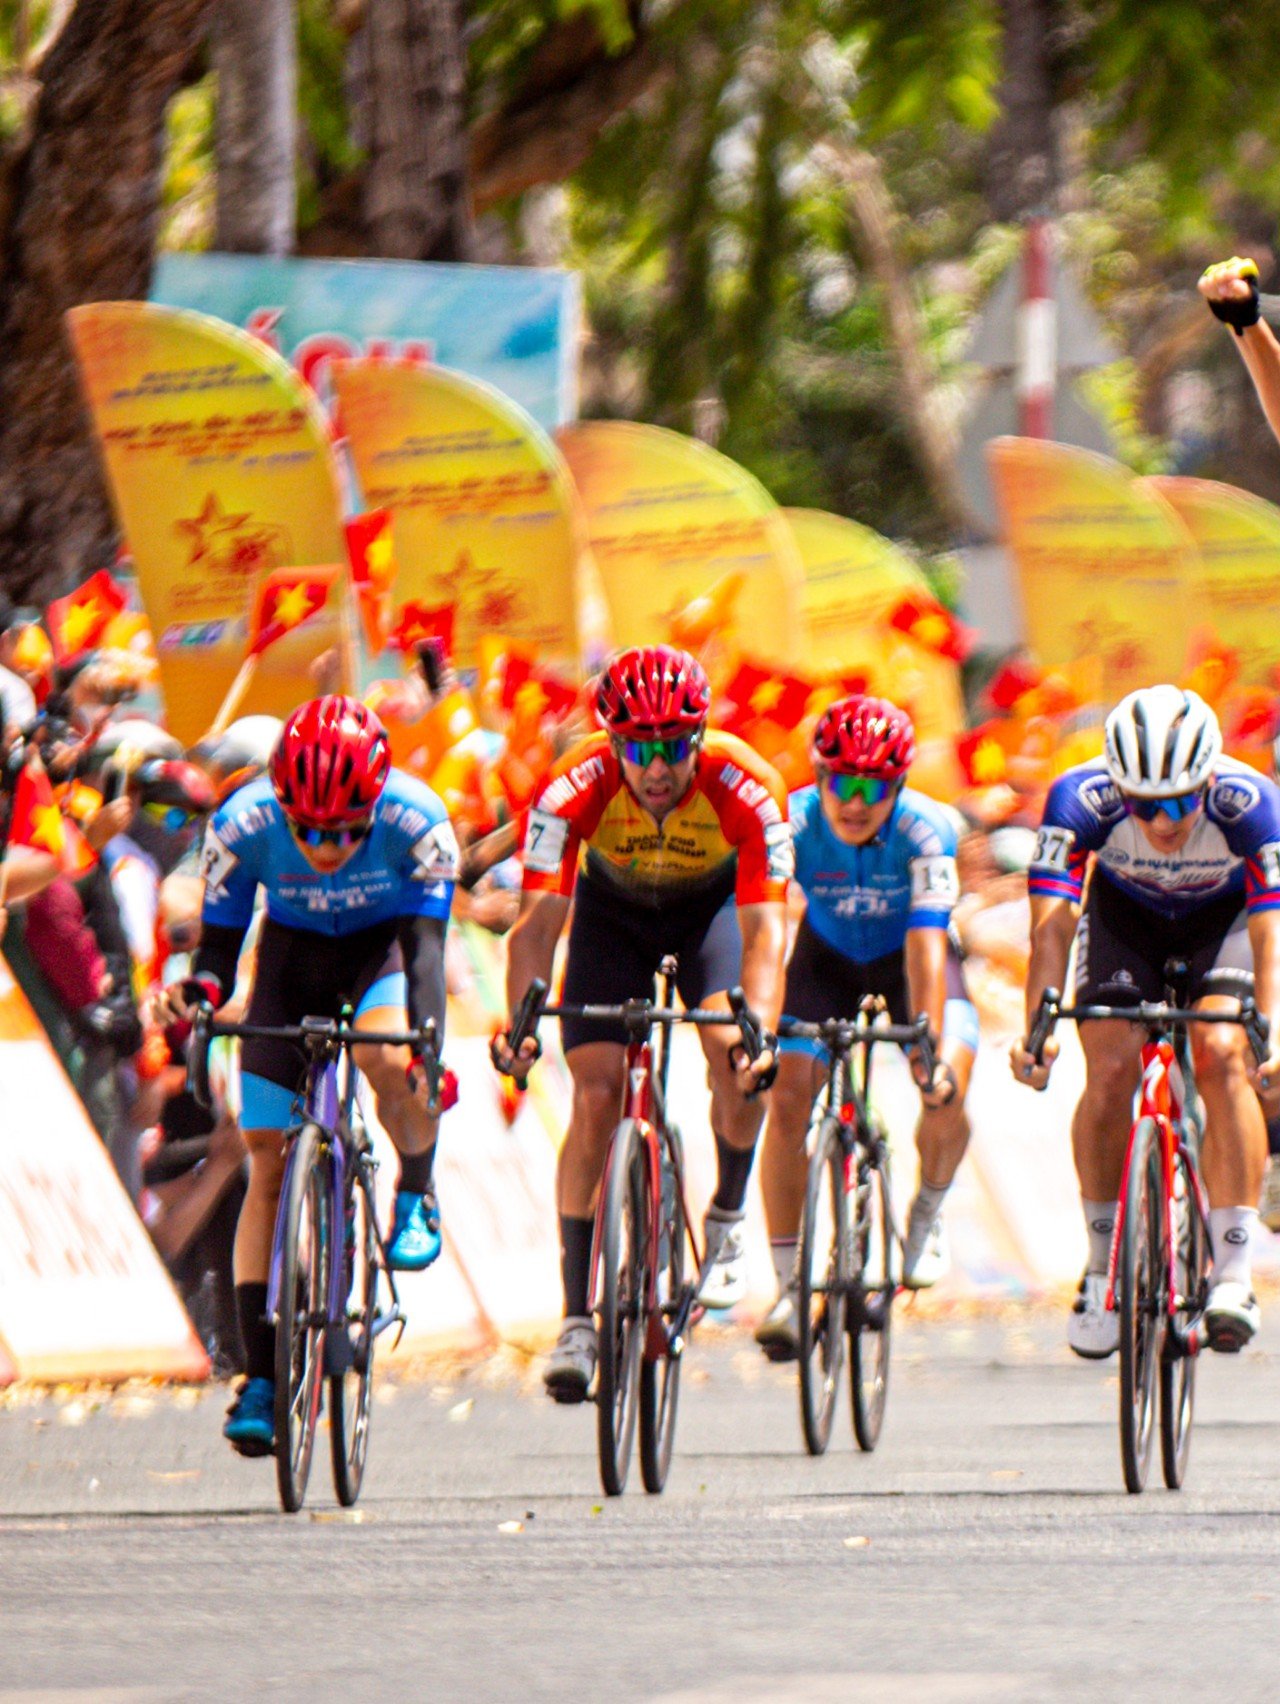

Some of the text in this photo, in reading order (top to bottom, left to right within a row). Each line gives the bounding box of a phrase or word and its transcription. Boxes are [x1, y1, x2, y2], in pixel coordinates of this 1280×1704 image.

[569, 755, 605, 791] CITY
[530, 822, 546, 851] 7
[1035, 831, 1065, 863] 37
